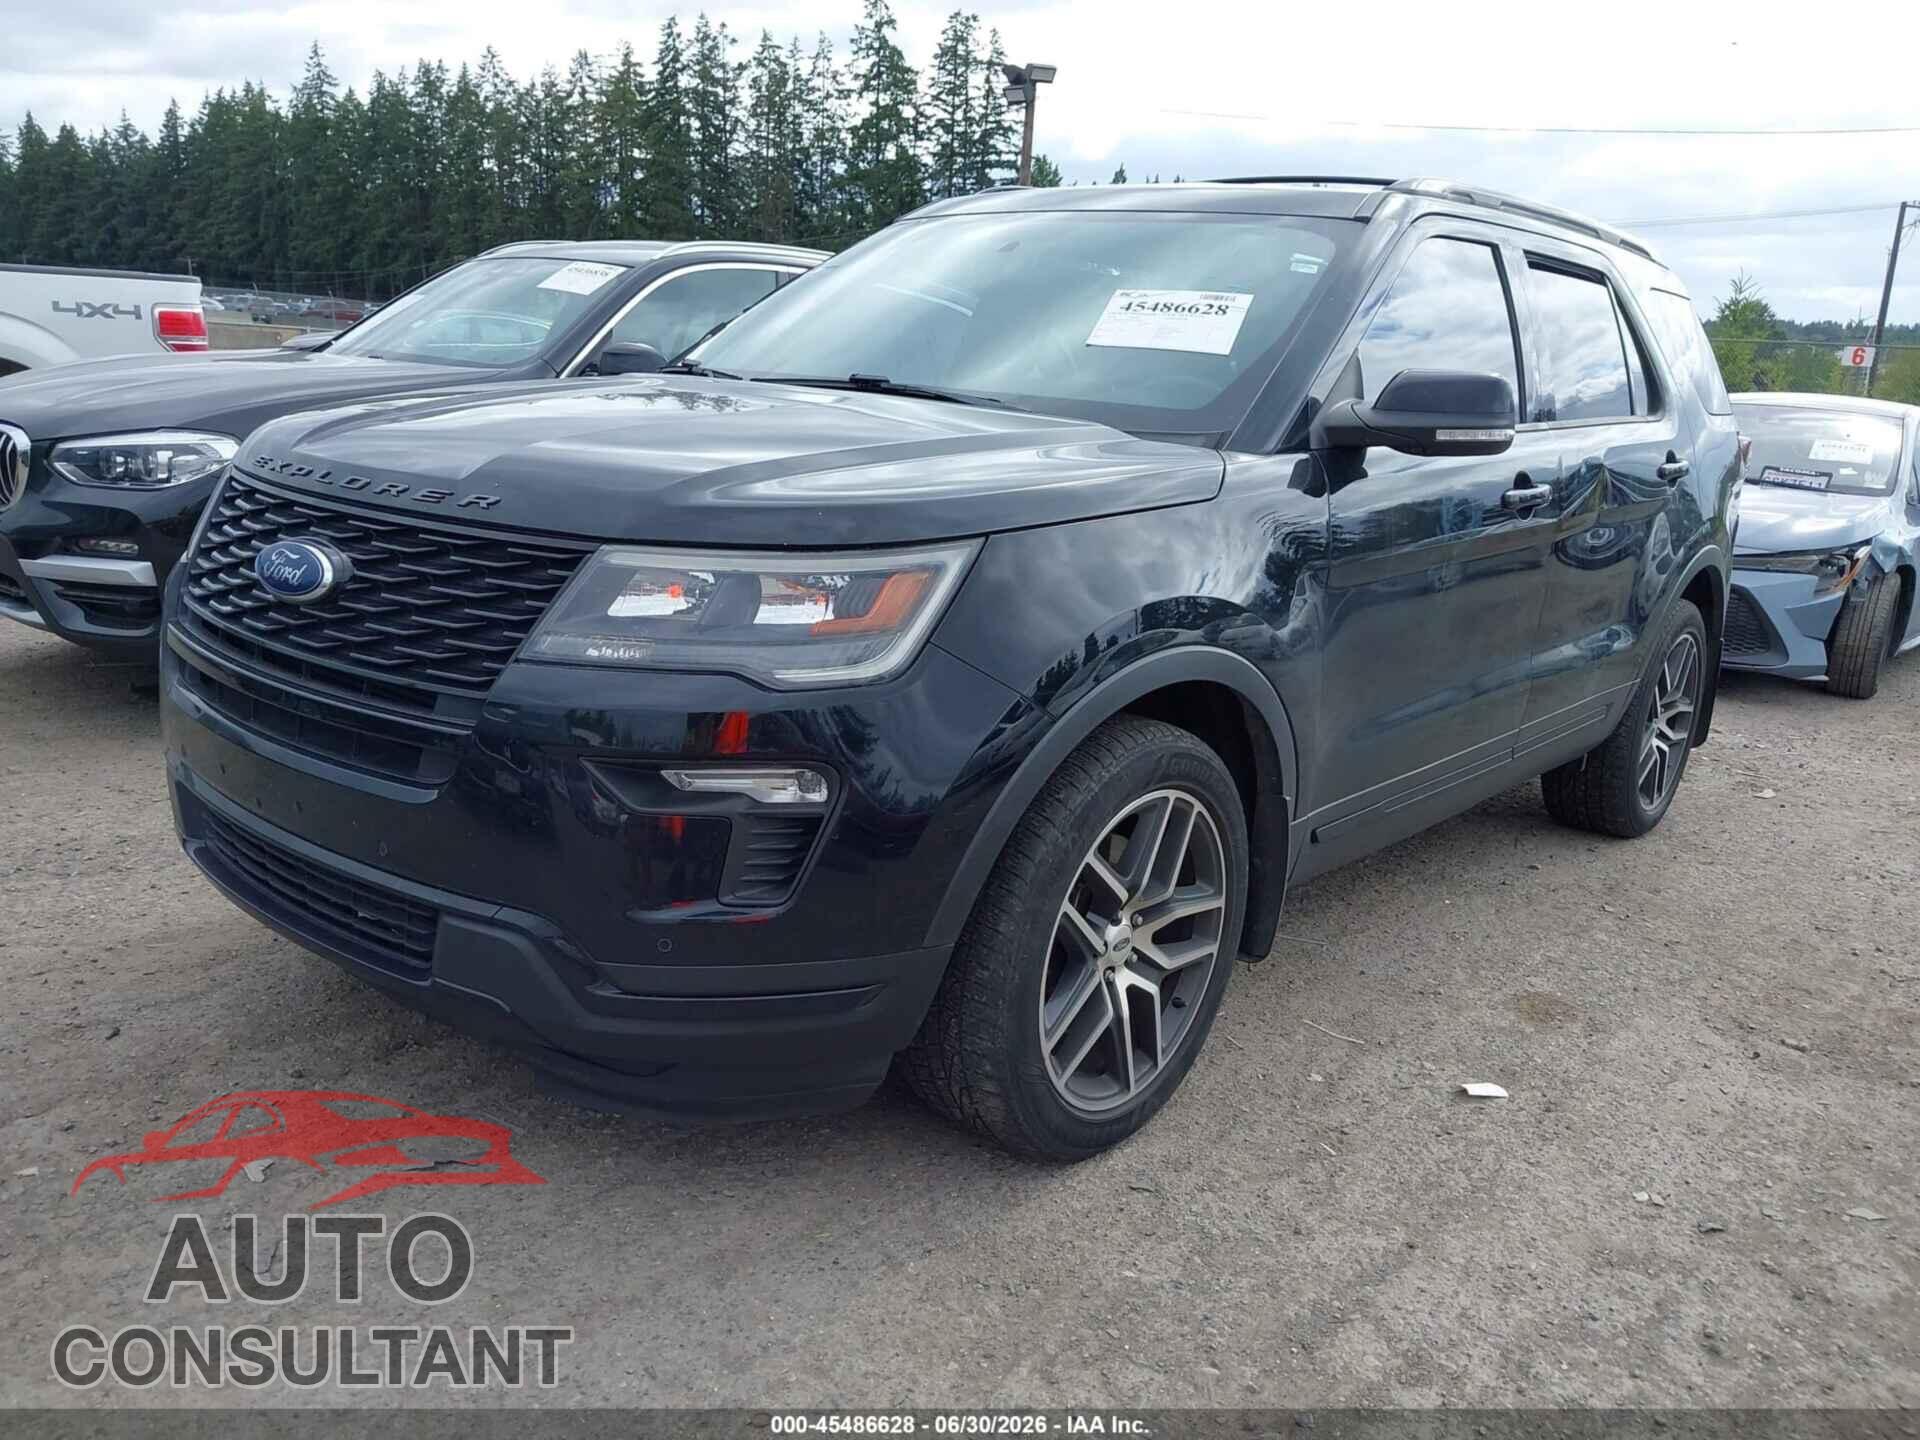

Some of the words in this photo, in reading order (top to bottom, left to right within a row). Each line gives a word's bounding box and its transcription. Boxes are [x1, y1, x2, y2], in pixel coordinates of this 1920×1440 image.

[52, 300, 142, 320] 4X4
[1119, 302, 1230, 316] 45486628
[1851, 347, 1865, 365] 6
[252, 456, 501, 509] EXPLORER
[264, 548, 307, 586] Ford
